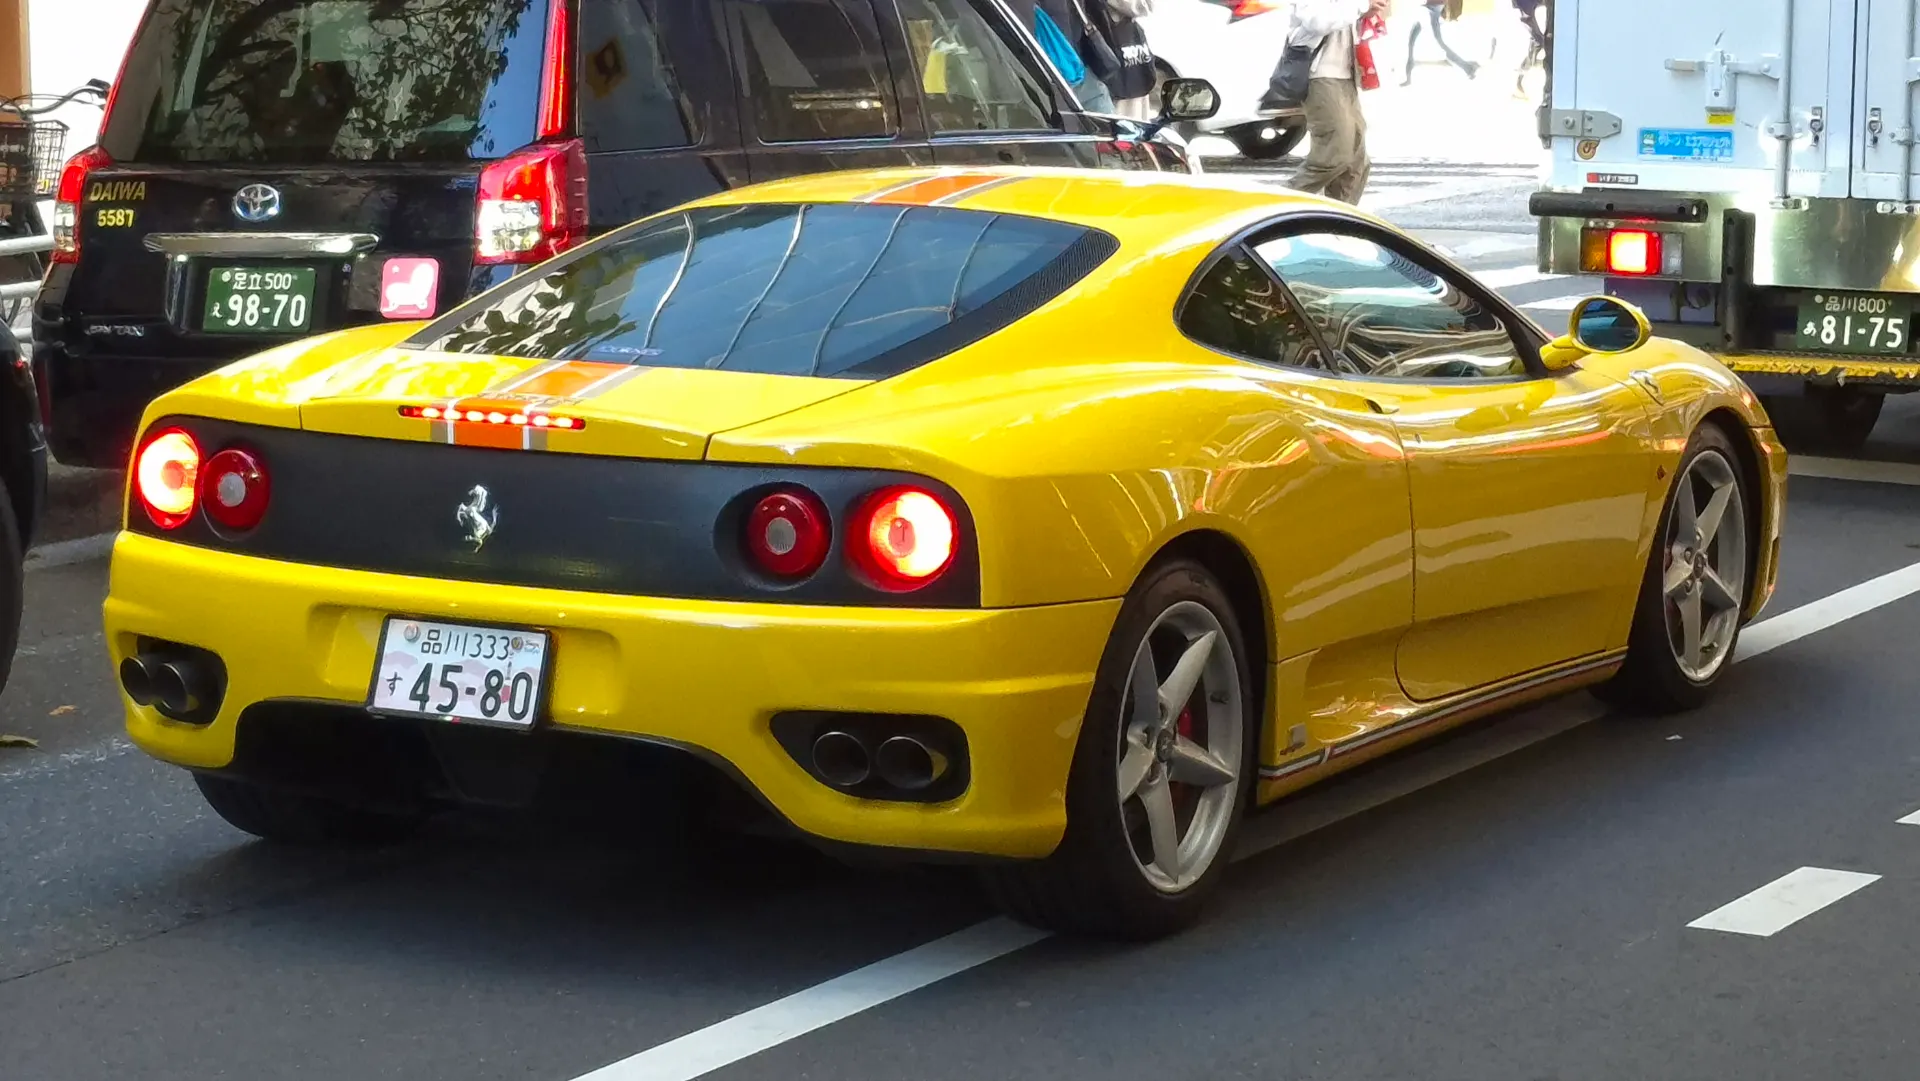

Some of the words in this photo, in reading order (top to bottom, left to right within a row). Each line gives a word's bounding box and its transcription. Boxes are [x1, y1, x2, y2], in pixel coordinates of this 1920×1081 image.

[90, 181, 146, 201] DAIWA
[97, 208, 135, 228] 5587
[232, 272, 263, 290] 足立
[264, 272, 292, 290] 500
[226, 294, 306, 327] 98-70
[1820, 315, 1904, 348] 81-75
[386, 672, 403, 697] す
[408, 662, 533, 721] 45-80
